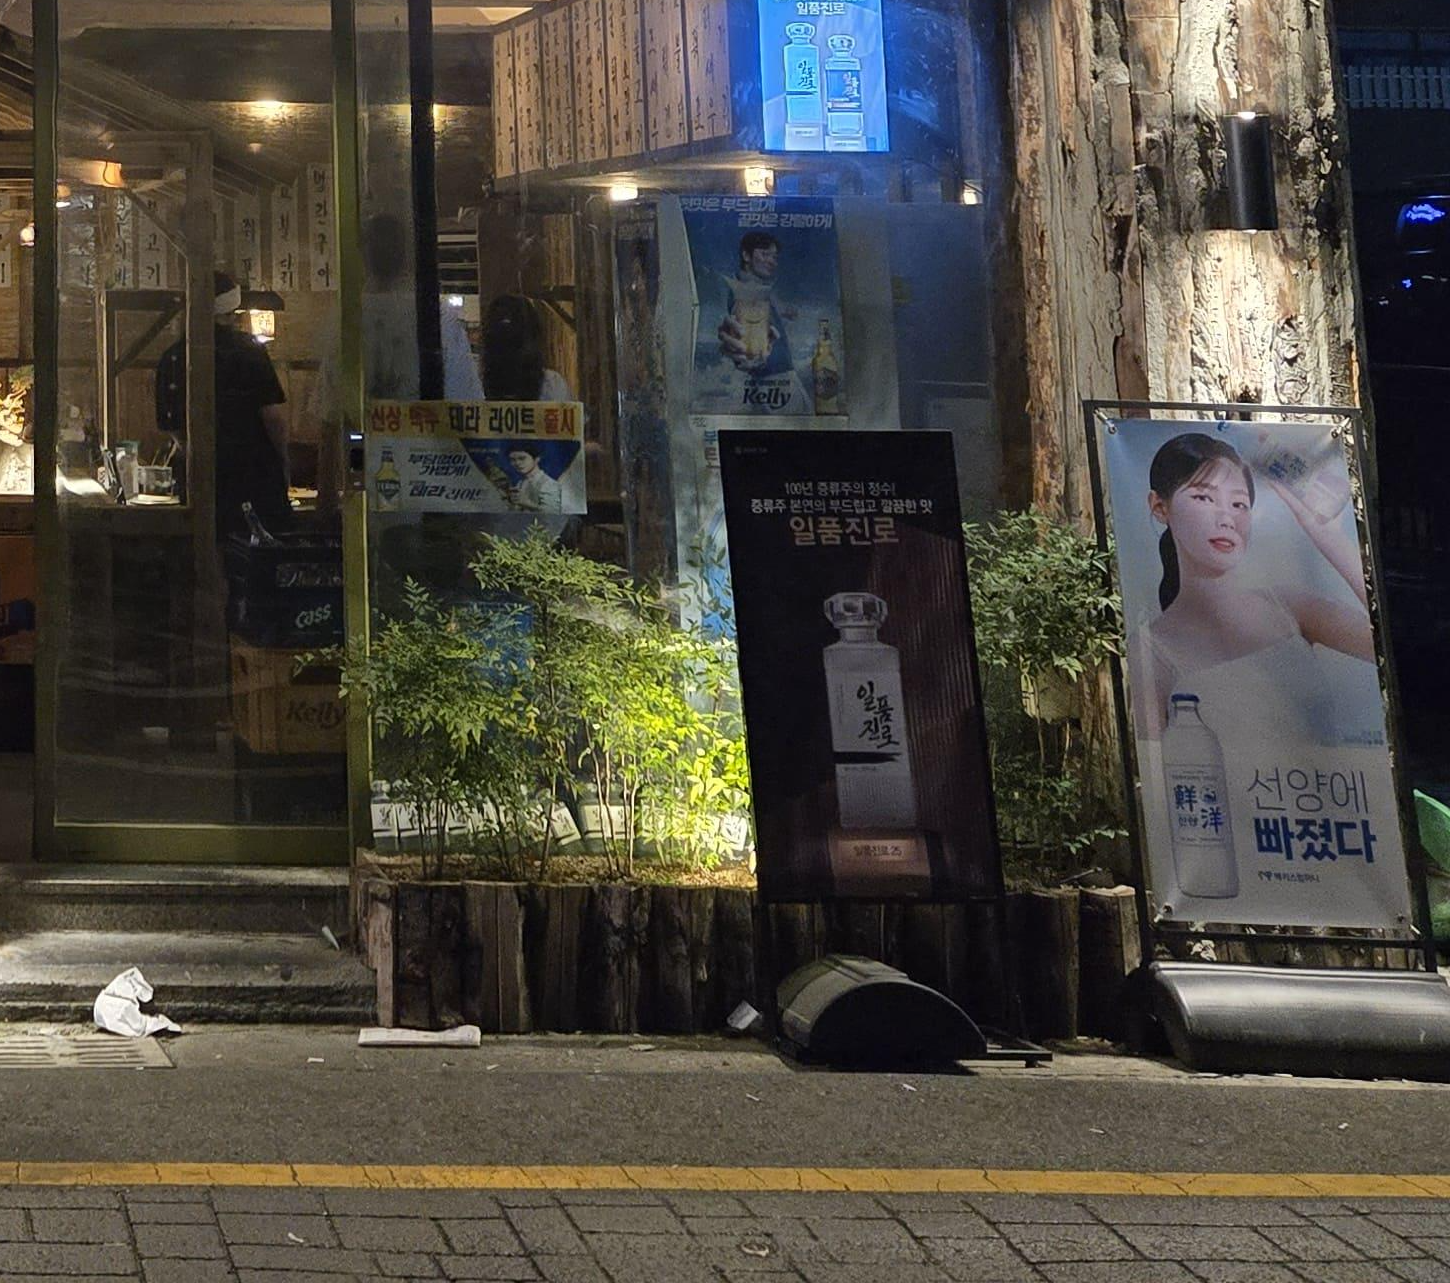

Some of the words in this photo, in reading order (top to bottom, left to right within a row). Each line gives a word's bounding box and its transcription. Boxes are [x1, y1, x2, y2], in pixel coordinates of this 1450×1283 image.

[796, 1, 846, 16] 일품진로
[742, 386, 791, 410] Kelly
[449, 405, 480, 434] 테라
[488, 406, 536, 435] 라이트
[543, 407, 576, 436] 출시
[783, 482, 814, 496] 100년
[816, 481, 865, 496] 증류주의
[750, 498, 787, 514] 증류주
[789, 498, 826, 514] 본연의
[829, 499, 878, 514] 부드럽고
[880, 499, 918, 515] 깔끔한
[919, 499, 933, 516] 맛
[788, 515, 900, 546] 일품진로
[285, 698, 347, 730] Kelly
[1247, 767, 1369, 814] 선양에
[1252, 816, 1377, 864] 빠졌다
